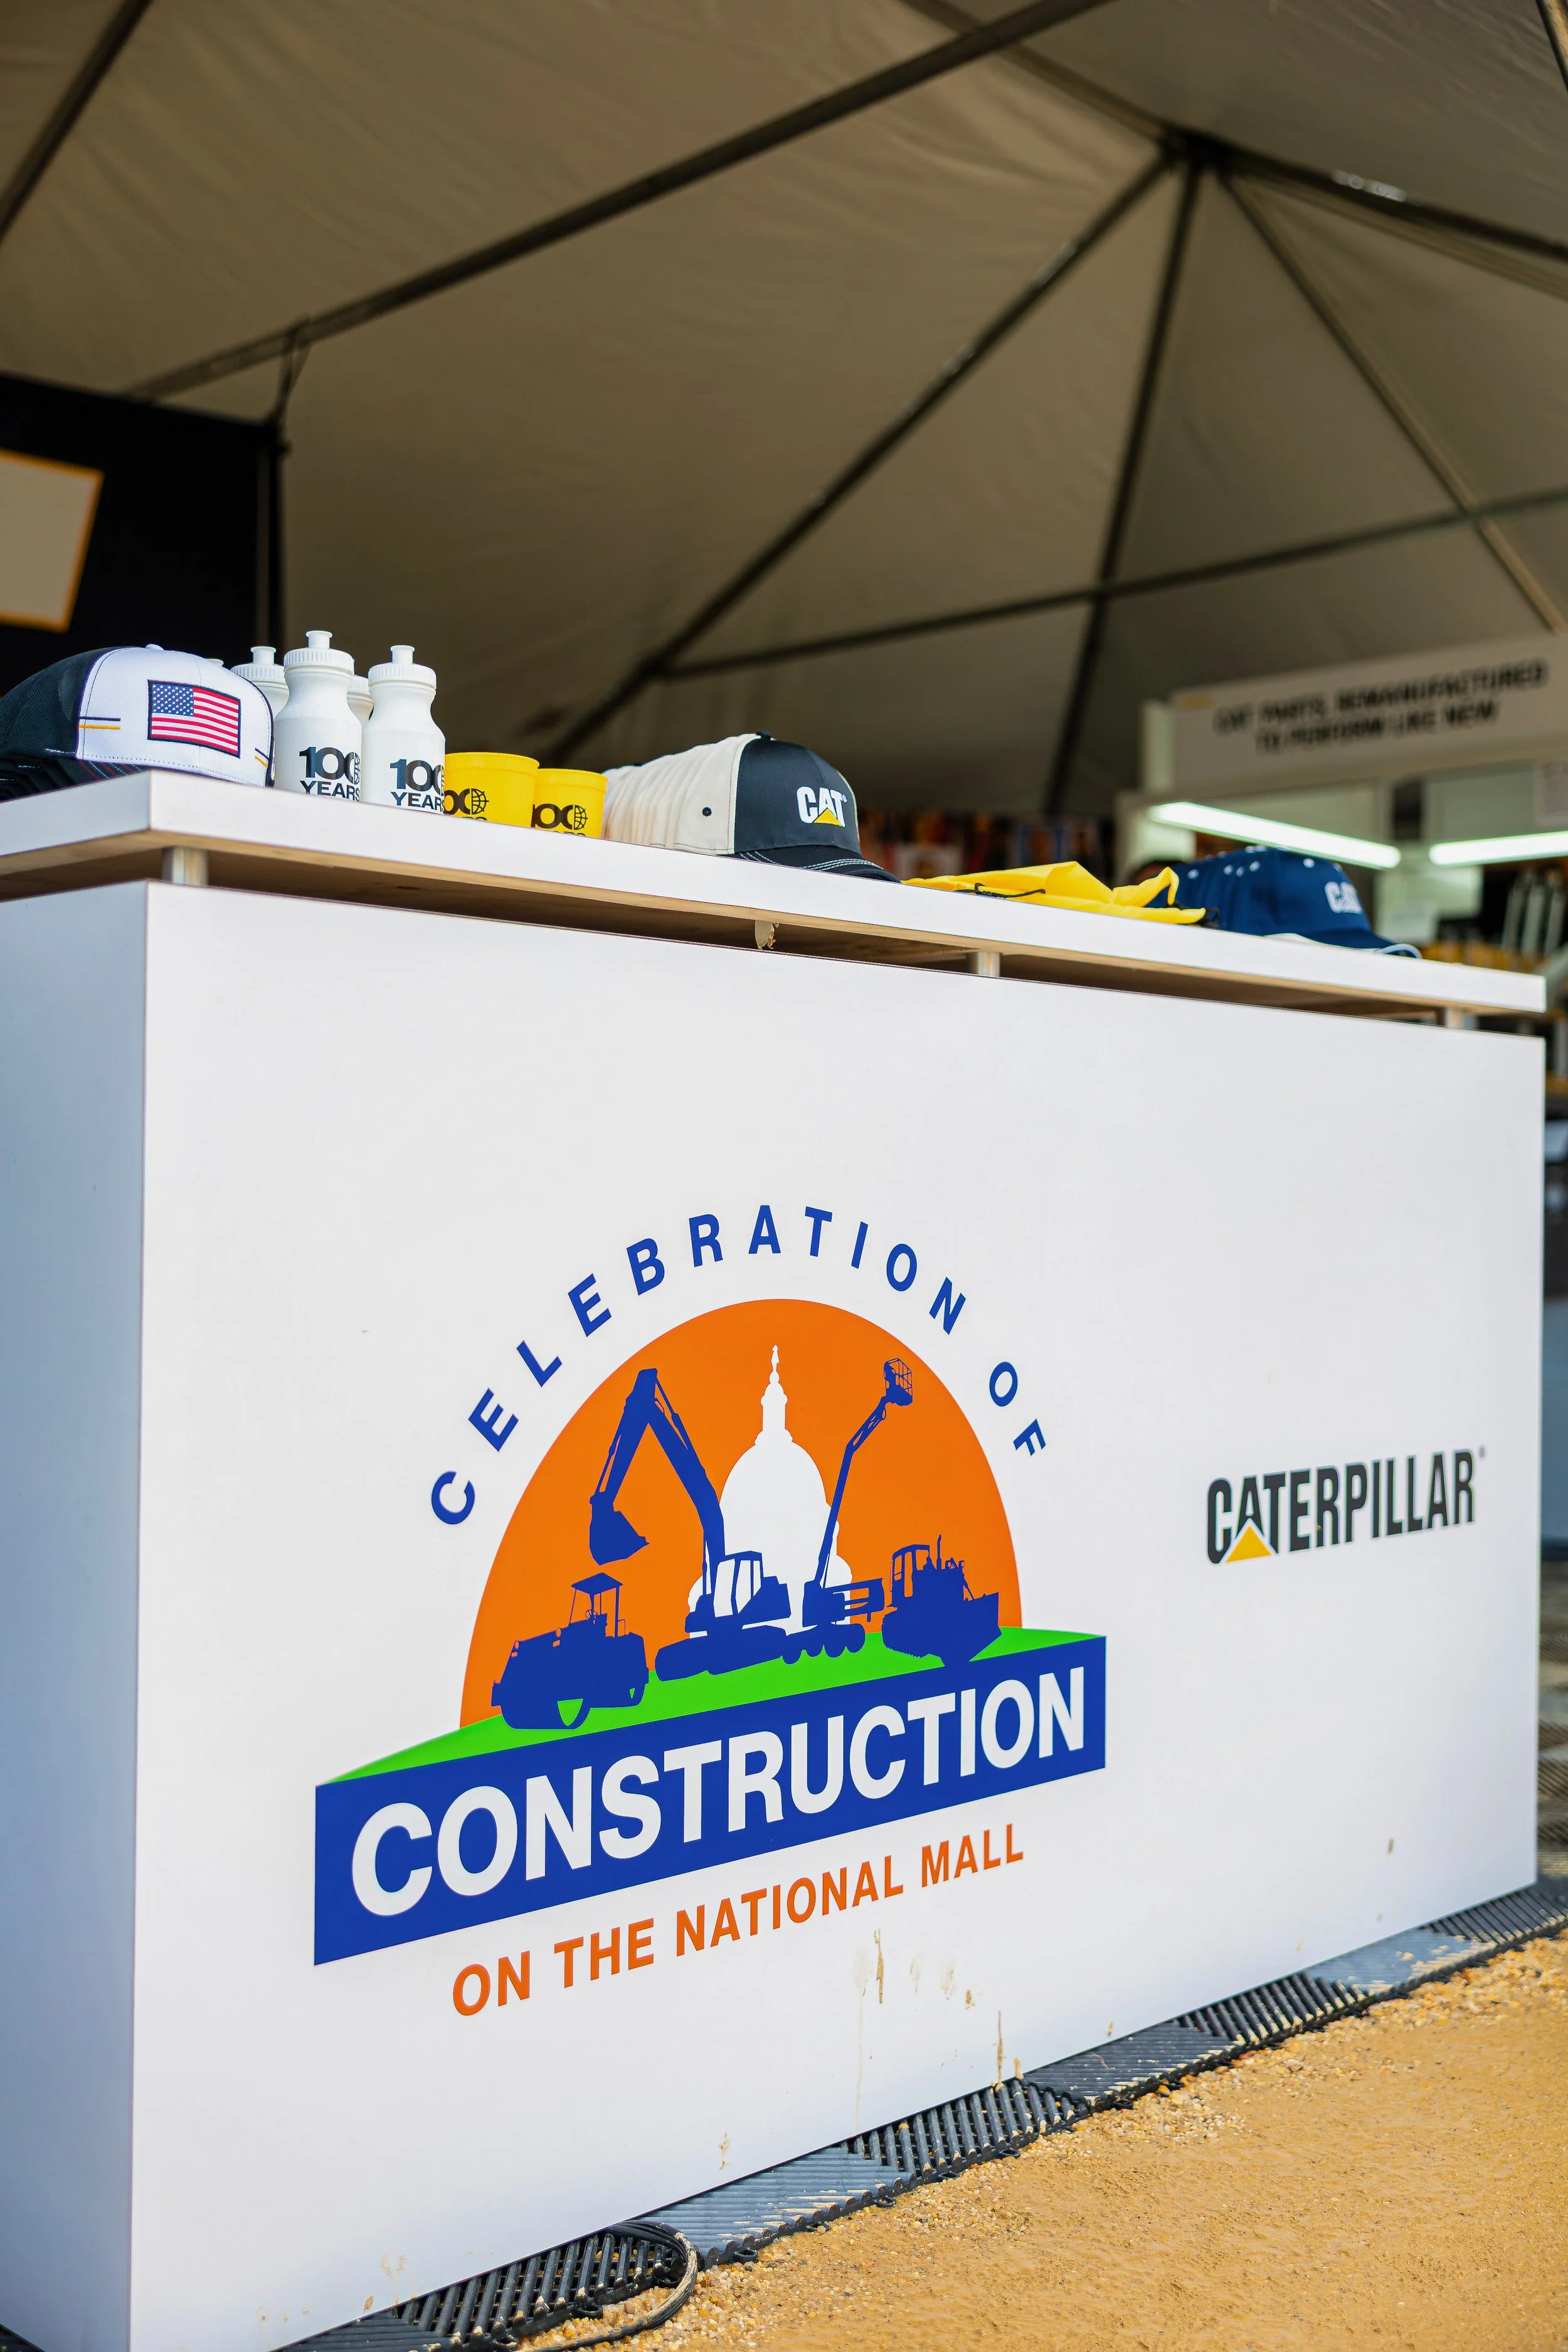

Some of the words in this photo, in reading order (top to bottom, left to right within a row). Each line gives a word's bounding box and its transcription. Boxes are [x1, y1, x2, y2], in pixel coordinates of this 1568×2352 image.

[299, 747, 361, 785] 100
[300, 780, 361, 802] YEARS
[797, 786, 845, 827] CAT
[432, 1205, 966, 1525] CELEBRATION
[989, 1362, 1046, 1456] OF
[1207, 1449, 1474, 1564] CATERPILLAR
[352, 1666, 1084, 1917] CONSTRUCTION
[453, 1951, 530, 2016] ON
[554, 1919, 654, 1988] THE
[677, 1855, 903, 1956] NATIONAL
[921, 1823, 1024, 1888] MALL
